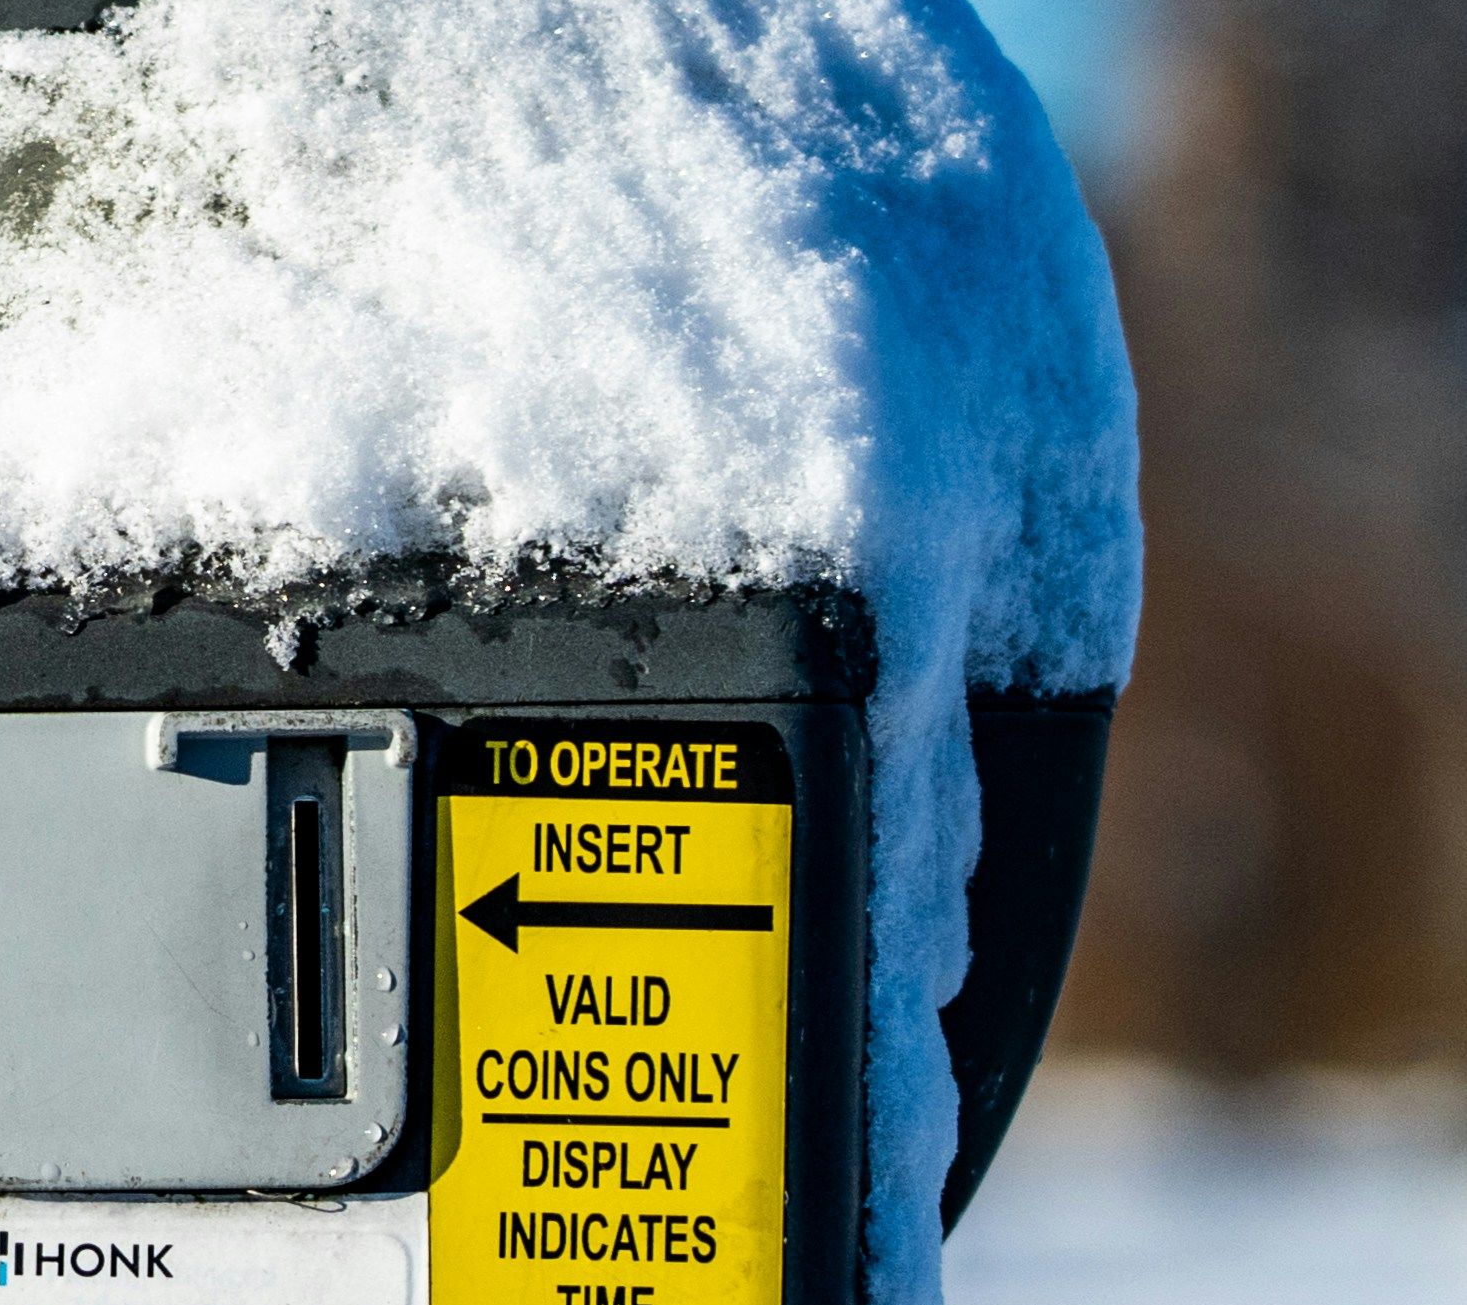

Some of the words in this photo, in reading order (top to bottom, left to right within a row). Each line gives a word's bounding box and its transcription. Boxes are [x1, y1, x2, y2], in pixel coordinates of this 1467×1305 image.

[486, 740, 538, 784] TO
[551, 741, 737, 788] OPERATE
[534, 823, 690, 874] INSERT
[546, 975, 670, 1026] VALID
[477, 1050, 609, 1101] COINS
[626, 1052, 739, 1103] ONLY
[523, 1141, 697, 1190] DISPLAY
[36, 1243, 173, 1278] HONK
[499, 1212, 716, 1263] INDICATES
